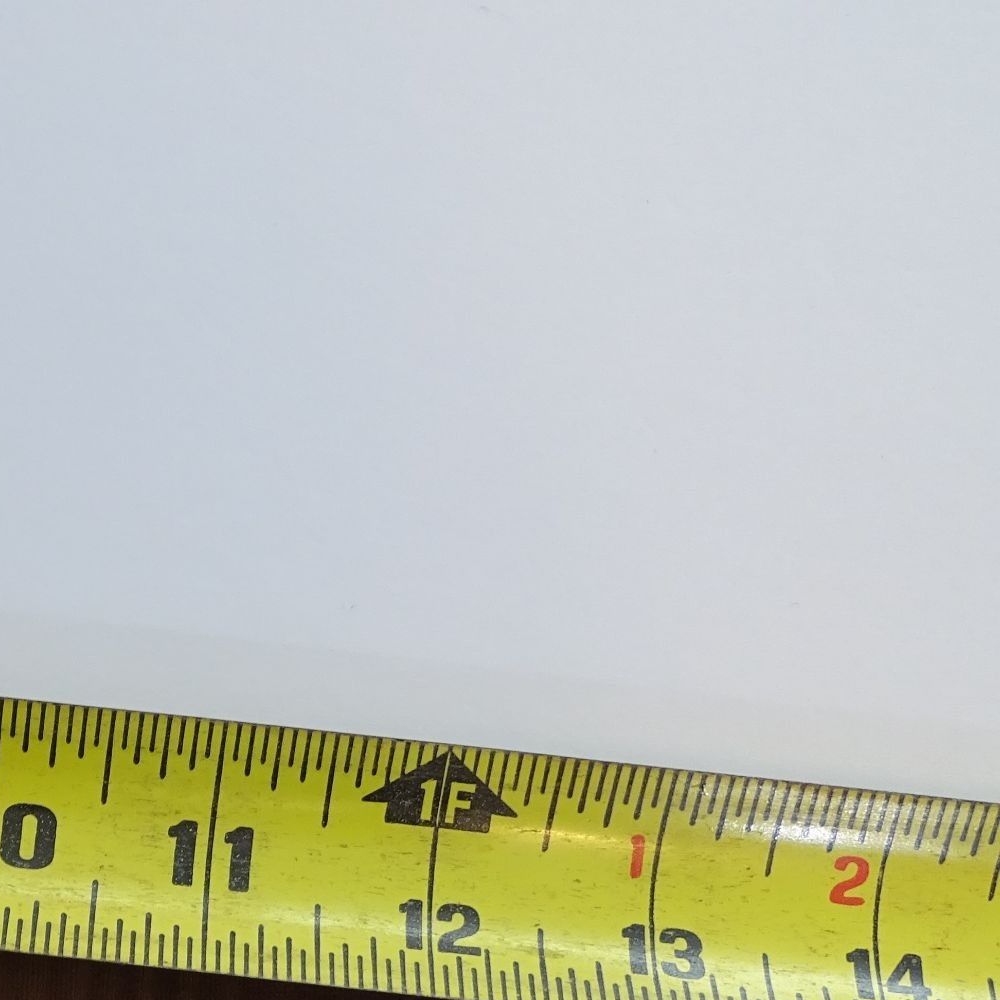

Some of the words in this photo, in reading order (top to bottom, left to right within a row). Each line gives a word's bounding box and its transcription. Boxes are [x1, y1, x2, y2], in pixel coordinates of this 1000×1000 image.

[419, 778, 476, 824] 1F
[168, 819, 254, 892] 11
[629, 834, 645, 879] 1
[829, 855, 870, 906] 2
[399, 898, 482, 957] 12
[621, 923, 706, 980] 13
